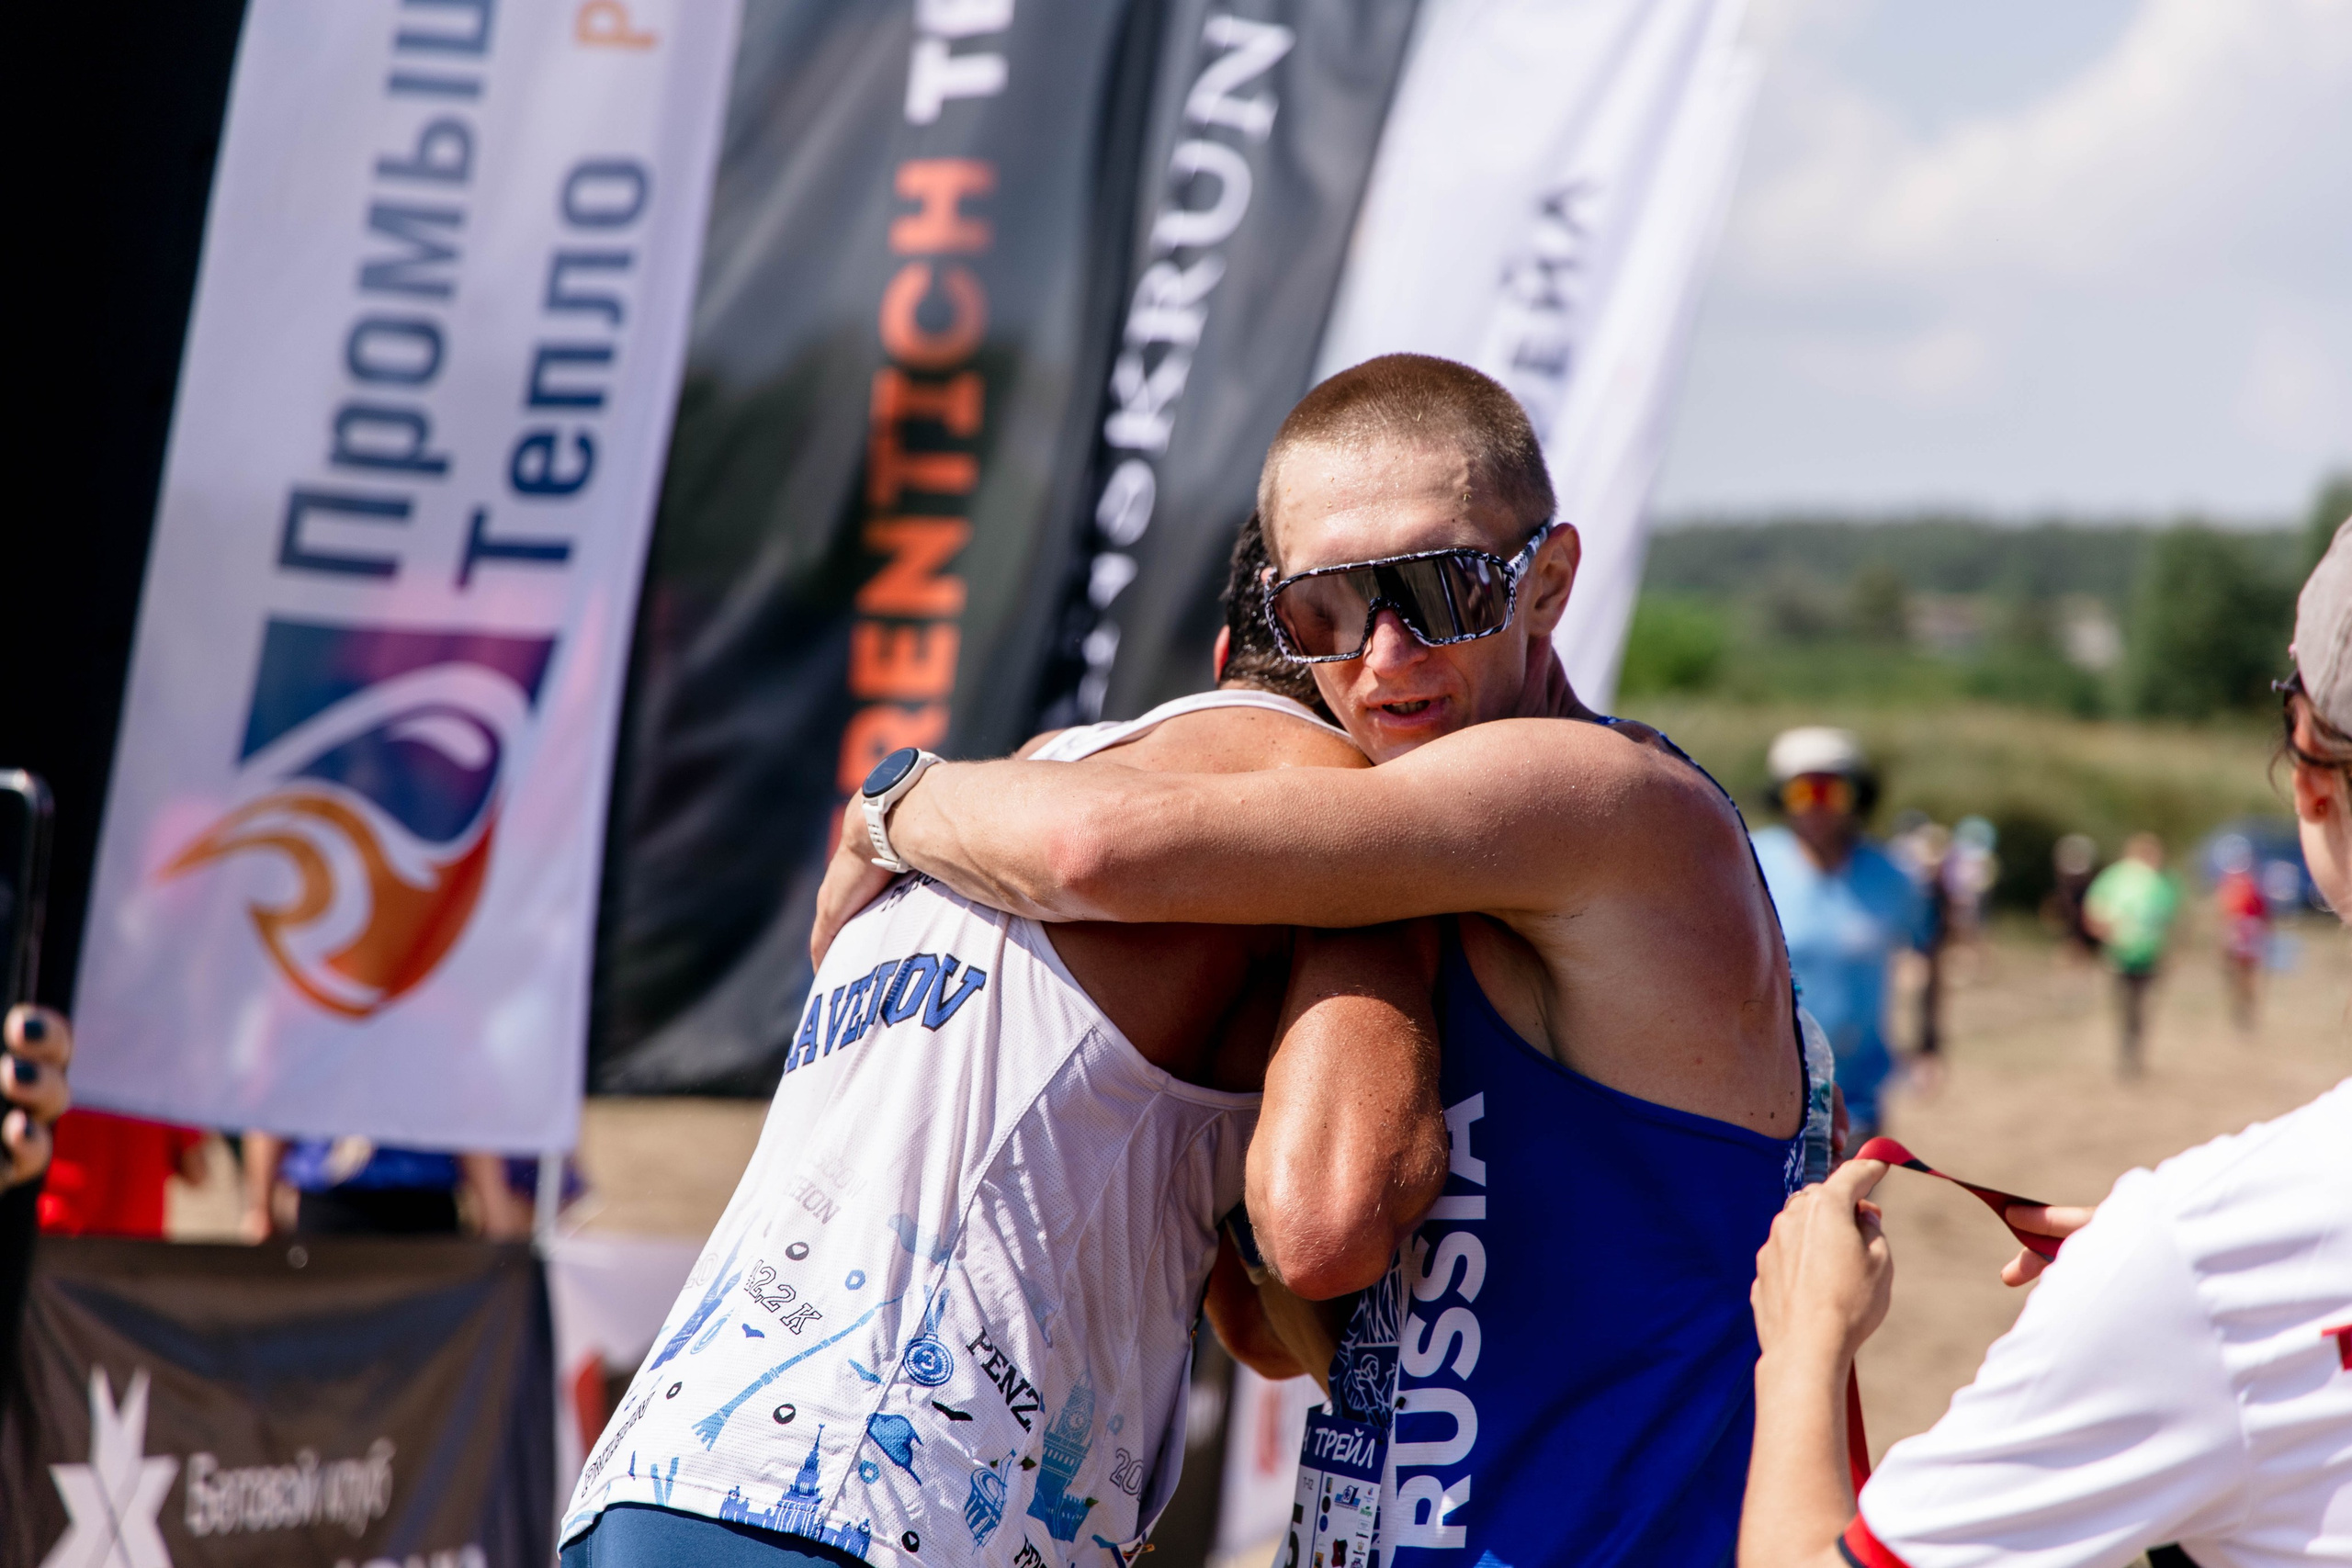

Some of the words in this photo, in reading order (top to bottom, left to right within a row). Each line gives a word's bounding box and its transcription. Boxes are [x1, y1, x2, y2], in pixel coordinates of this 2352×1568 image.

[452, 158, 653, 594] Тепло
[829, 158, 997, 865] RENTICH
[781, 1303, 822, 1335] K
[1395, 1091, 1487, 1550] RUSSIA
[966, 1325, 1040, 1433] PENZ
[1110, 1448, 1143, 1503] 20
[1315, 1427, 1376, 1469] ТРЕЙЛ
